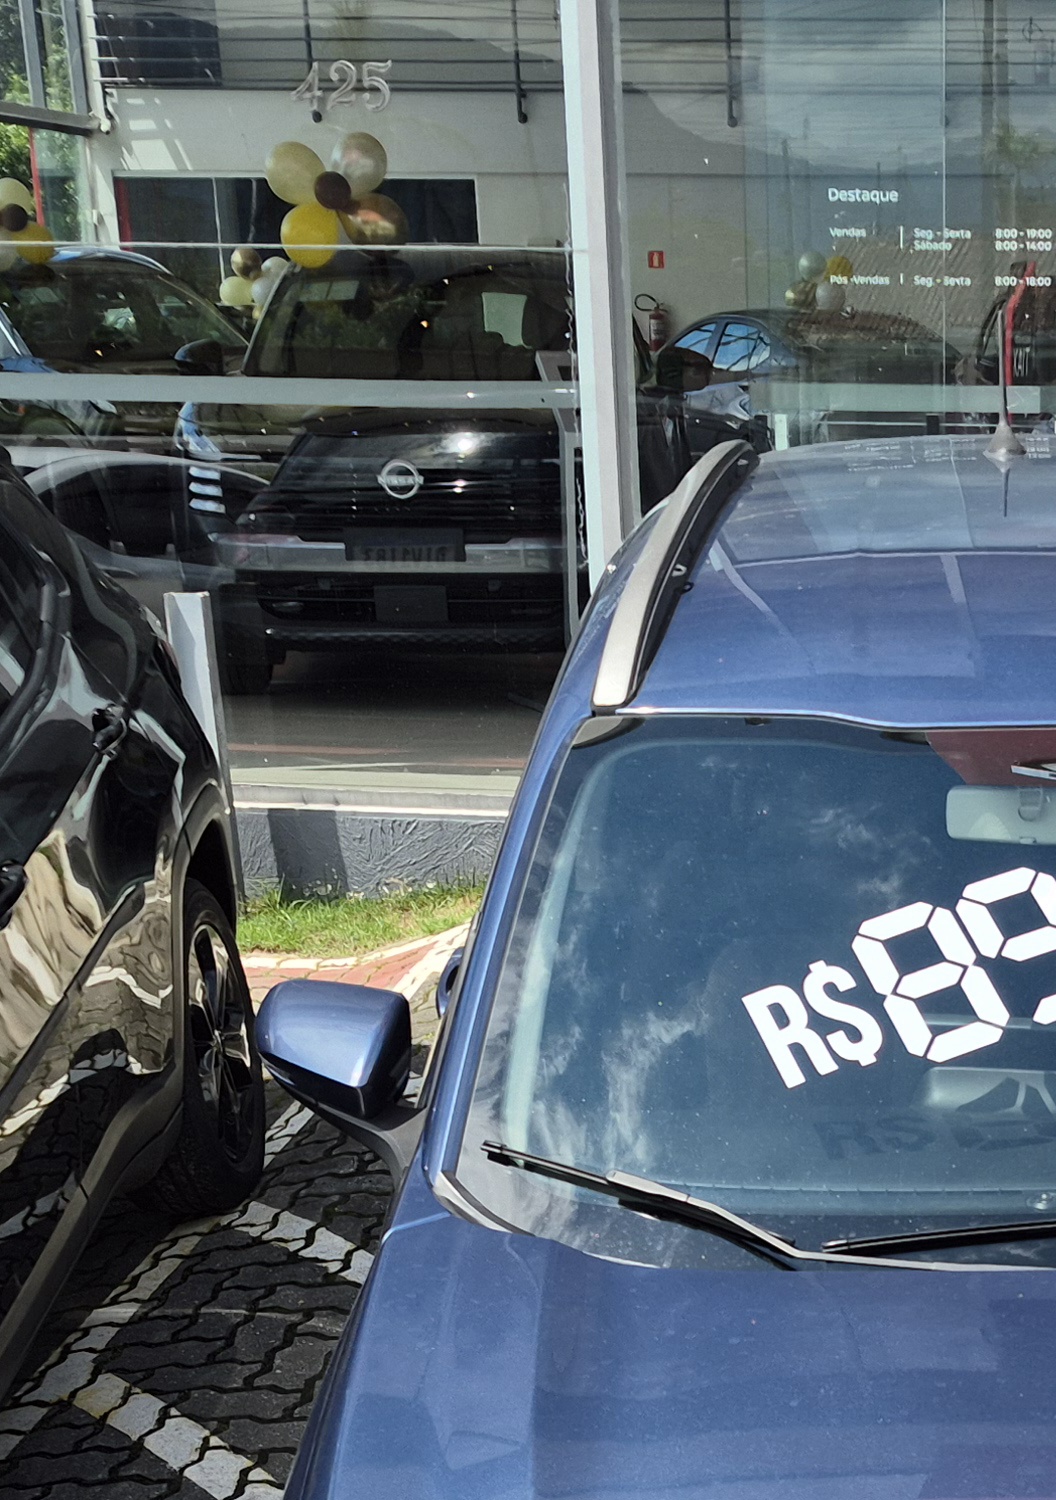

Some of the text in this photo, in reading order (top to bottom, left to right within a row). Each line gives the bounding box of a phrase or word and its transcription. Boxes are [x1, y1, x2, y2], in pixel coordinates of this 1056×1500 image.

[290, 59, 392, 112] 425
[828, 188, 899, 205] Destaque
[829, 227, 867, 238] Vendas
[943, 227, 972, 239] Sexta
[995, 228, 1018, 239] 8:00
[913, 239, 953, 251] Sábado
[995, 240, 1018, 251] 8:00
[995, 276, 1018, 286] 8:00
[1025, 276, 1053, 286] 18:00
